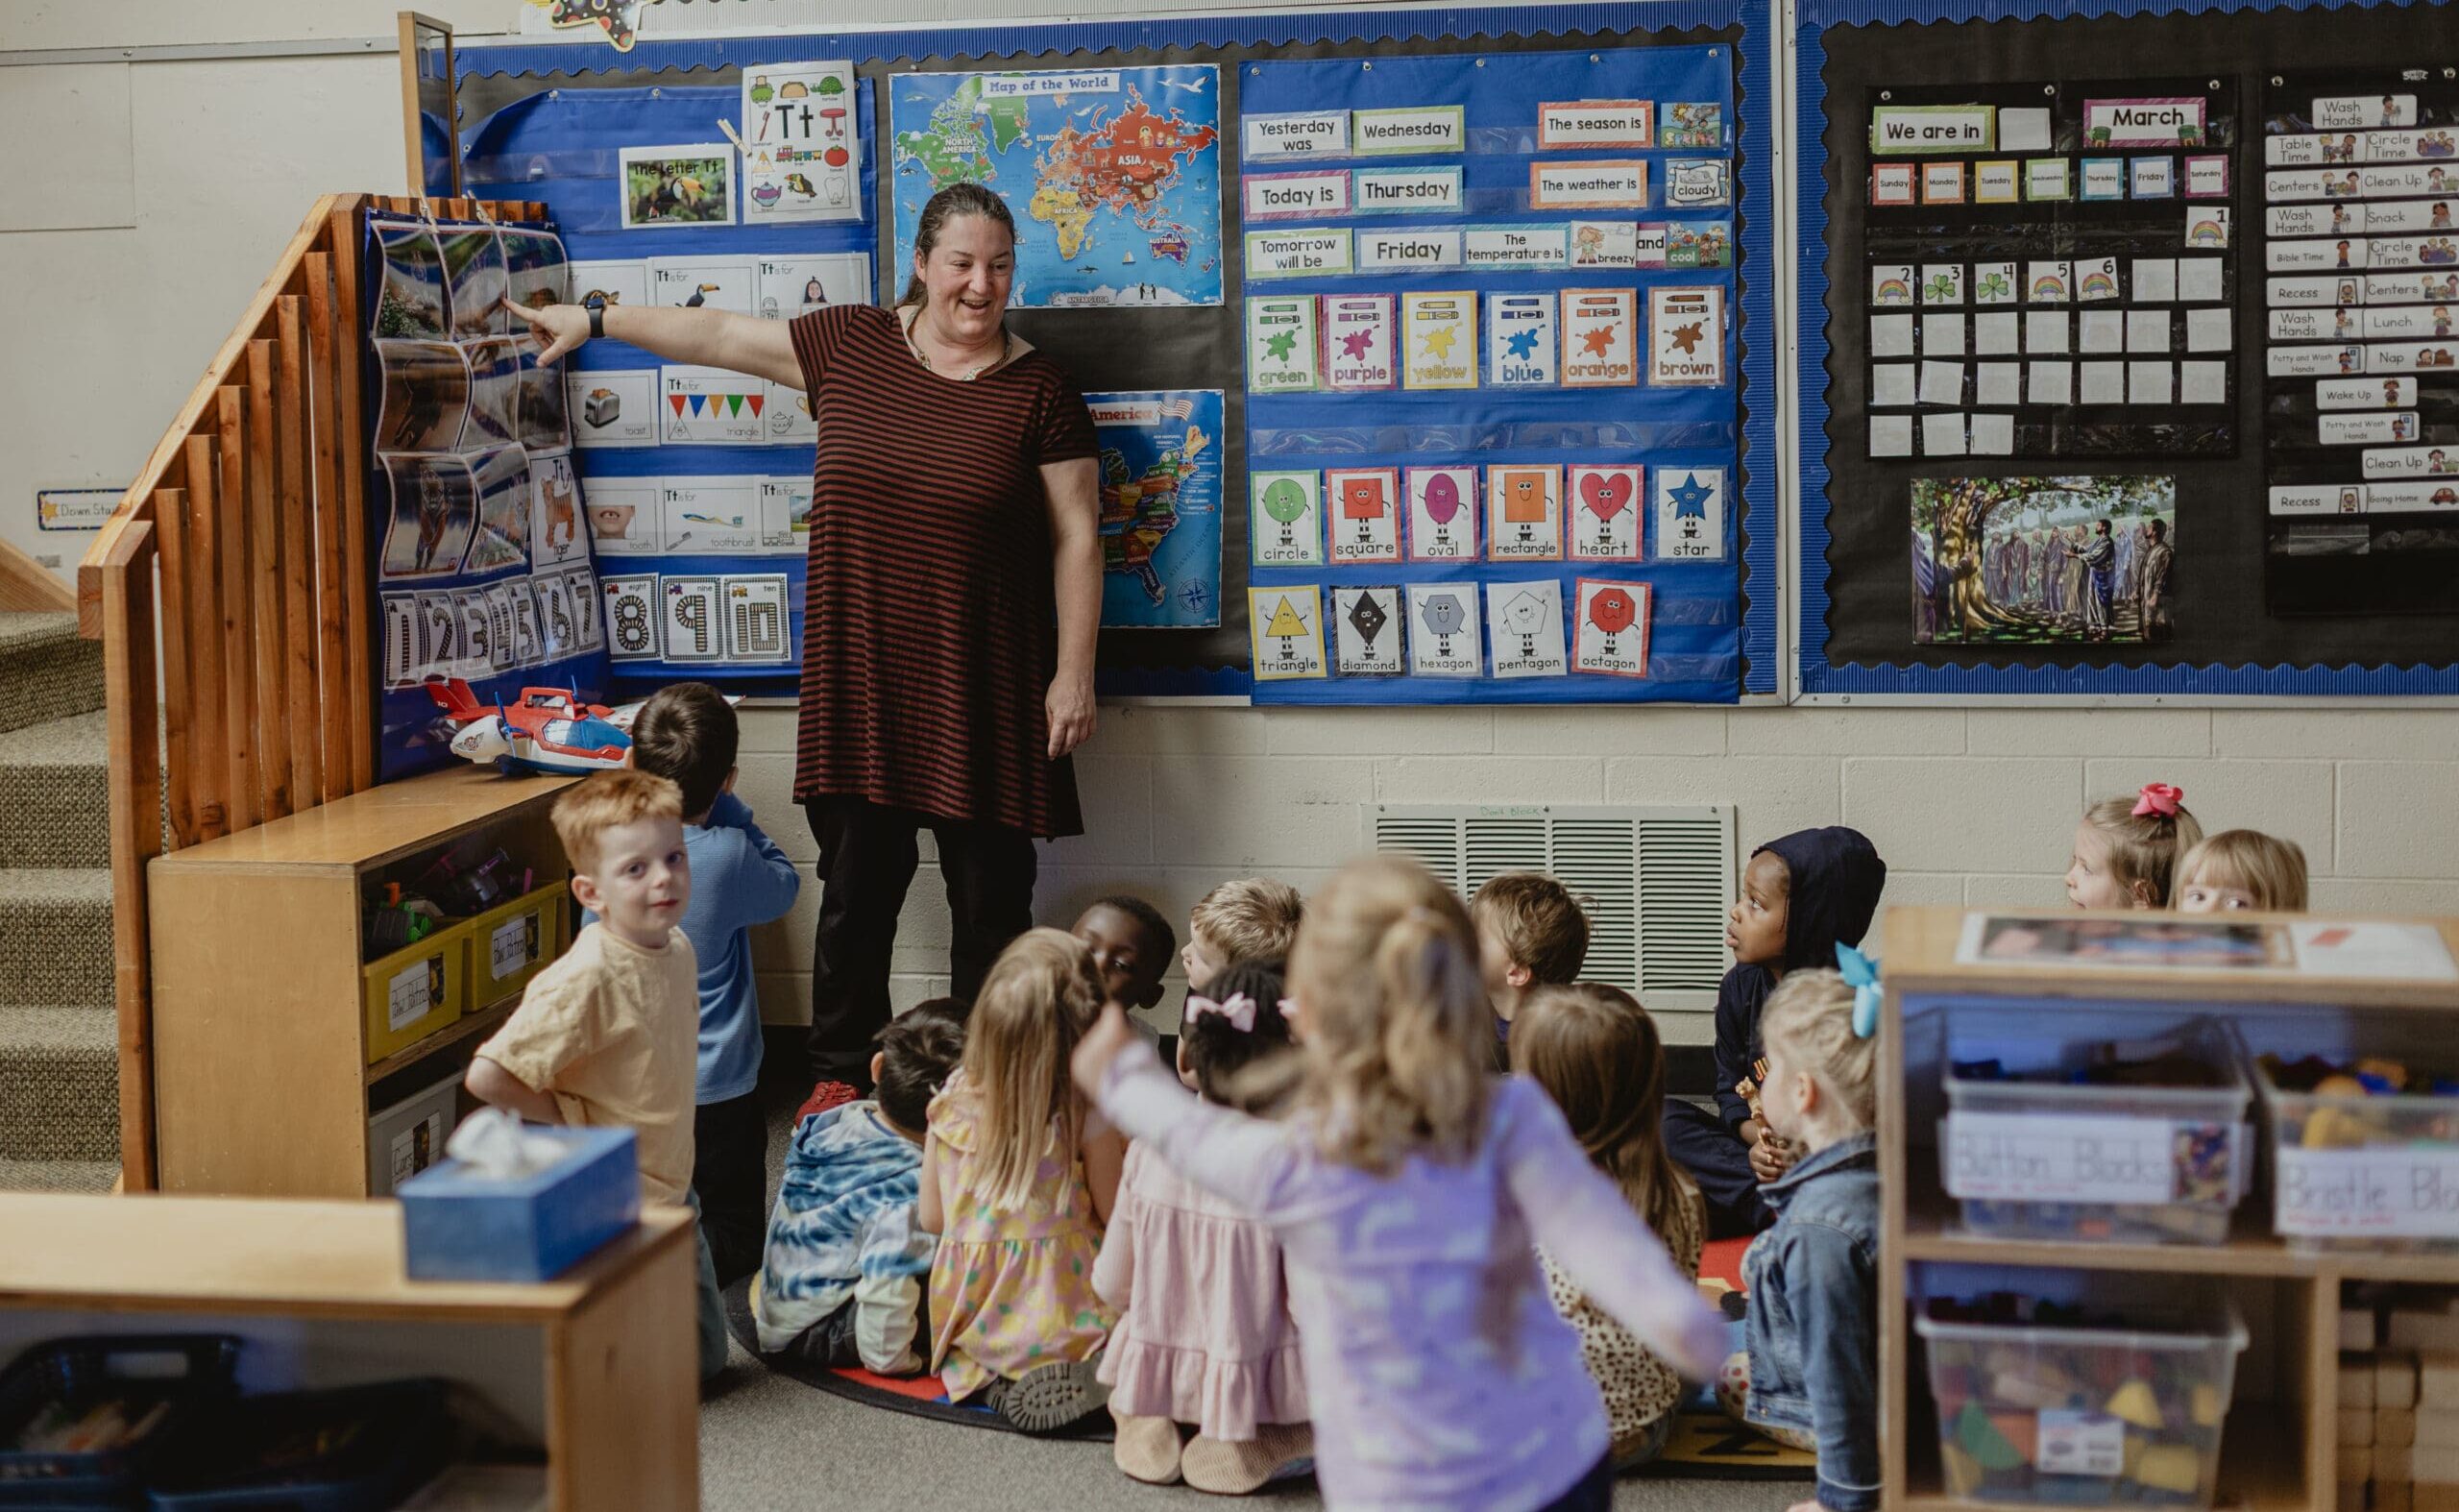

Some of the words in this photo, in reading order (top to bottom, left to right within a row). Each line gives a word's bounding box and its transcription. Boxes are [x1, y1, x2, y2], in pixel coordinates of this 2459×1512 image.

[989, 82, 1016, 93] Map
[1022, 81, 1035, 90] of
[1041, 80, 1062, 90] the
[1069, 77, 1108, 88] World
[2324, 101, 2361, 112] Wash
[775, 105, 814, 138] Tt
[2113, 108, 2184, 126] March
[2322, 114, 2363, 126] Hands
[1259, 120, 1335, 135] Yesterday
[1364, 122, 1451, 138] Wednesday
[1548, 118, 1572, 131] The
[1577, 118, 1625, 130] season
[1631, 117, 1642, 130] is
[1887, 123, 1915, 139] We
[1922, 126, 1957, 139] are
[1964, 123, 1980, 138] in
[944, 137, 973, 146] NORTH
[1283, 139, 1312, 151] was
[2278, 138, 2312, 150] Table
[2369, 134, 2411, 145] Circle
[942, 145, 977, 155] AMERICA
[2280, 151, 2310, 162] Time
[2374, 146, 2406, 158] Time
[1118, 156, 1141, 165] ASIA
[634, 162, 657, 176] The
[659, 160, 699, 174] Letter
[703, 159, 718, 172] Tt
[1880, 180, 1910, 188] Sunday
[2137, 173, 2165, 182] Friday
[2364, 176, 2400, 187] Clean
[2405, 175, 2422, 186] Up
[1365, 182, 1449, 200] Thursday
[1543, 180, 1564, 191] The
[1569, 179, 1622, 190] weather
[1627, 178, 1637, 189] is
[1677, 185, 1716, 197] cloudy
[2269, 181, 2319, 192] Centers
[1262, 188, 1314, 206] Today
[1321, 186, 1333, 202] is
[2216, 209, 2227, 223] 1
[2277, 209, 2312, 221] Wash
[2368, 211, 2405, 223] Snack
[2276, 222, 2315, 233] Hands
[1504, 234, 1526, 245] The
[1637, 236, 1664, 249] and
[1260, 239, 1336, 254] Tomorrow
[1377, 241, 1442, 260] Friday
[2371, 241, 2414, 253] Circle
[1468, 249, 1550, 260] temperature
[1554, 248, 1564, 259] is
[1597, 254, 1636, 264] breezy
[1670, 251, 1695, 262] cool
[2276, 254, 2300, 262] Bible
[2303, 253, 2325, 261] Time
[2375, 254, 2409, 265] Time
[1276, 256, 1299, 269] will
[1304, 255, 1322, 267] be
[2103, 260, 2113, 275] 6
[761, 263, 773, 275] Tt
[781, 264, 793, 275] for
[1901, 267, 1911, 281] 2
[1950, 266, 1960, 280] 3
[2003, 264, 2014, 279] 4
[2058, 263, 2068, 278] 5
[656, 270, 669, 282] Tt
[676, 271, 689, 281] for
[2278, 288, 2319, 299] Recess
[2367, 284, 2419, 296] Centers
[2280, 313, 2315, 324] Wash
[2374, 316, 2413, 328] Lunch
[2277, 326, 2317, 336] Hands
[2274, 354, 2295, 363] Potty
[2311, 353, 2333, 361] Wash
[2379, 352, 2404, 365] Nap
[1334, 366, 1387, 382] purple
[1413, 365, 1468, 381] yellow
[1502, 365, 1544, 381] blue
[1568, 362, 1629, 378] orange
[1660, 361, 1716, 376] brown
[2291, 365, 2315, 374] Hands
[669, 379, 681, 390] Tt
[688, 381, 699, 391] for
[1259, 372, 1307, 385] green
[2326, 391, 2354, 400] Wake
[2356, 391, 2372, 402] Up
[1089, 407, 1152, 421] America
[625, 427, 645, 435] toast
[726, 427, 759, 441] triangle
[2366, 458, 2401, 470] Clean
[2405, 456, 2423, 469] Up
[666, 490, 677, 501] Tt
[685, 493, 696, 501] for
[762, 484, 775, 496] Tt
[783, 487, 796, 496] for
[2280, 497, 2321, 507] Recess
[2369, 496, 2392, 505] Going
[2394, 495, 2420, 503] Home
[61, 503, 91, 517] Down
[553, 541, 571, 561] tiger
[1264, 545, 1309, 560] circle
[1336, 543, 1395, 558] square
[1427, 545, 1459, 556] oval
[1496, 542, 1556, 556] rectangle
[1580, 540, 1629, 555] heart
[1673, 542, 1710, 556] star
[628, 583, 647, 593] eight
[551, 589, 571, 648] 6
[576, 585, 592, 643] 7
[518, 599, 534, 656] 5
[614, 595, 650, 651] 8
[675, 595, 708, 652] 9
[736, 602, 779, 652] 10
[432, 607, 452, 661] 2
[468, 608, 489, 658] 3
[492, 603, 510, 660] 4
[402, 614, 410, 677] 1
[1260, 657, 1318, 672] triangle
[1342, 659, 1396, 671] diamond
[1420, 656, 1473, 671] hexagon
[1498, 658, 1560, 671] pentagon
[1582, 656, 1637, 671] octagon
[1510, 807, 1541, 817] Block
[2284, 1163, 2387, 1209] Bristle
